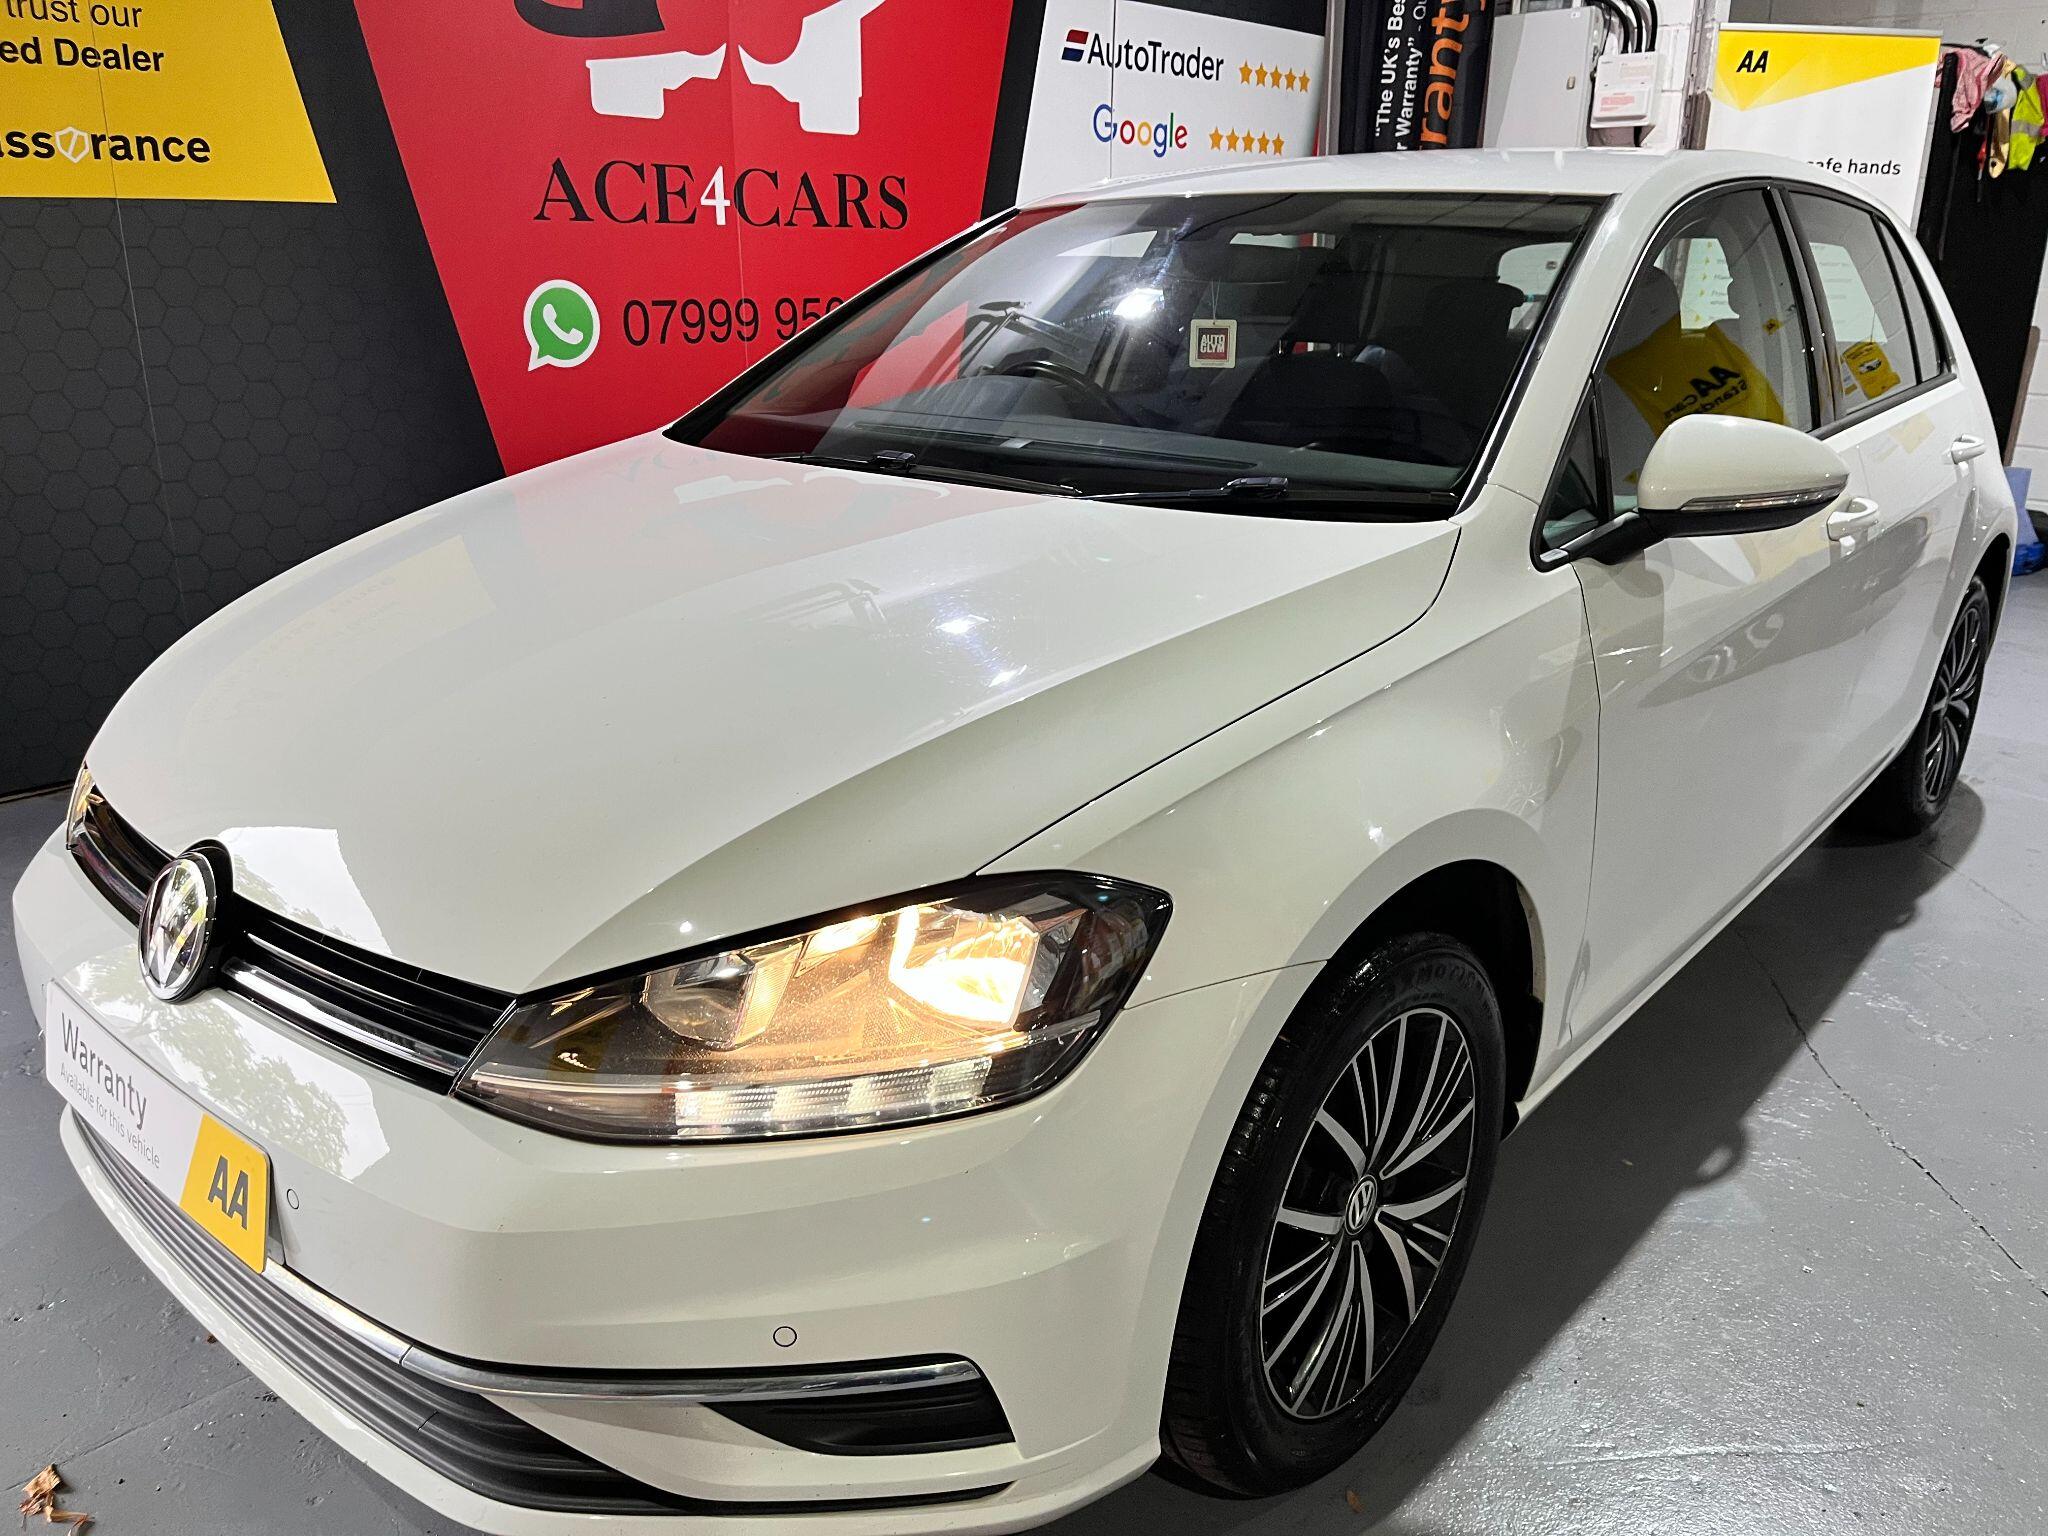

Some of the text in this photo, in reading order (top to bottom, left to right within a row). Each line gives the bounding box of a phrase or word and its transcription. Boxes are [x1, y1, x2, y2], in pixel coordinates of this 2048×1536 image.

[6, 0, 142, 27] trust our
[0, 37, 164, 72] ed Dealer
[1087, 33, 1225, 81] AutoTrader
[1736, 50, 1769, 73] AA
[1093, 103, 1188, 158] Google
[1808, 157, 1901, 175] fe hands
[533, 157, 908, 230] ACE4CARS
[622, 297, 846, 346] 07999 95
[61, 1012, 147, 1130] Warranty
[60, 1062, 160, 1169] Available for this vehicle
[208, 1155, 249, 1230] AA
